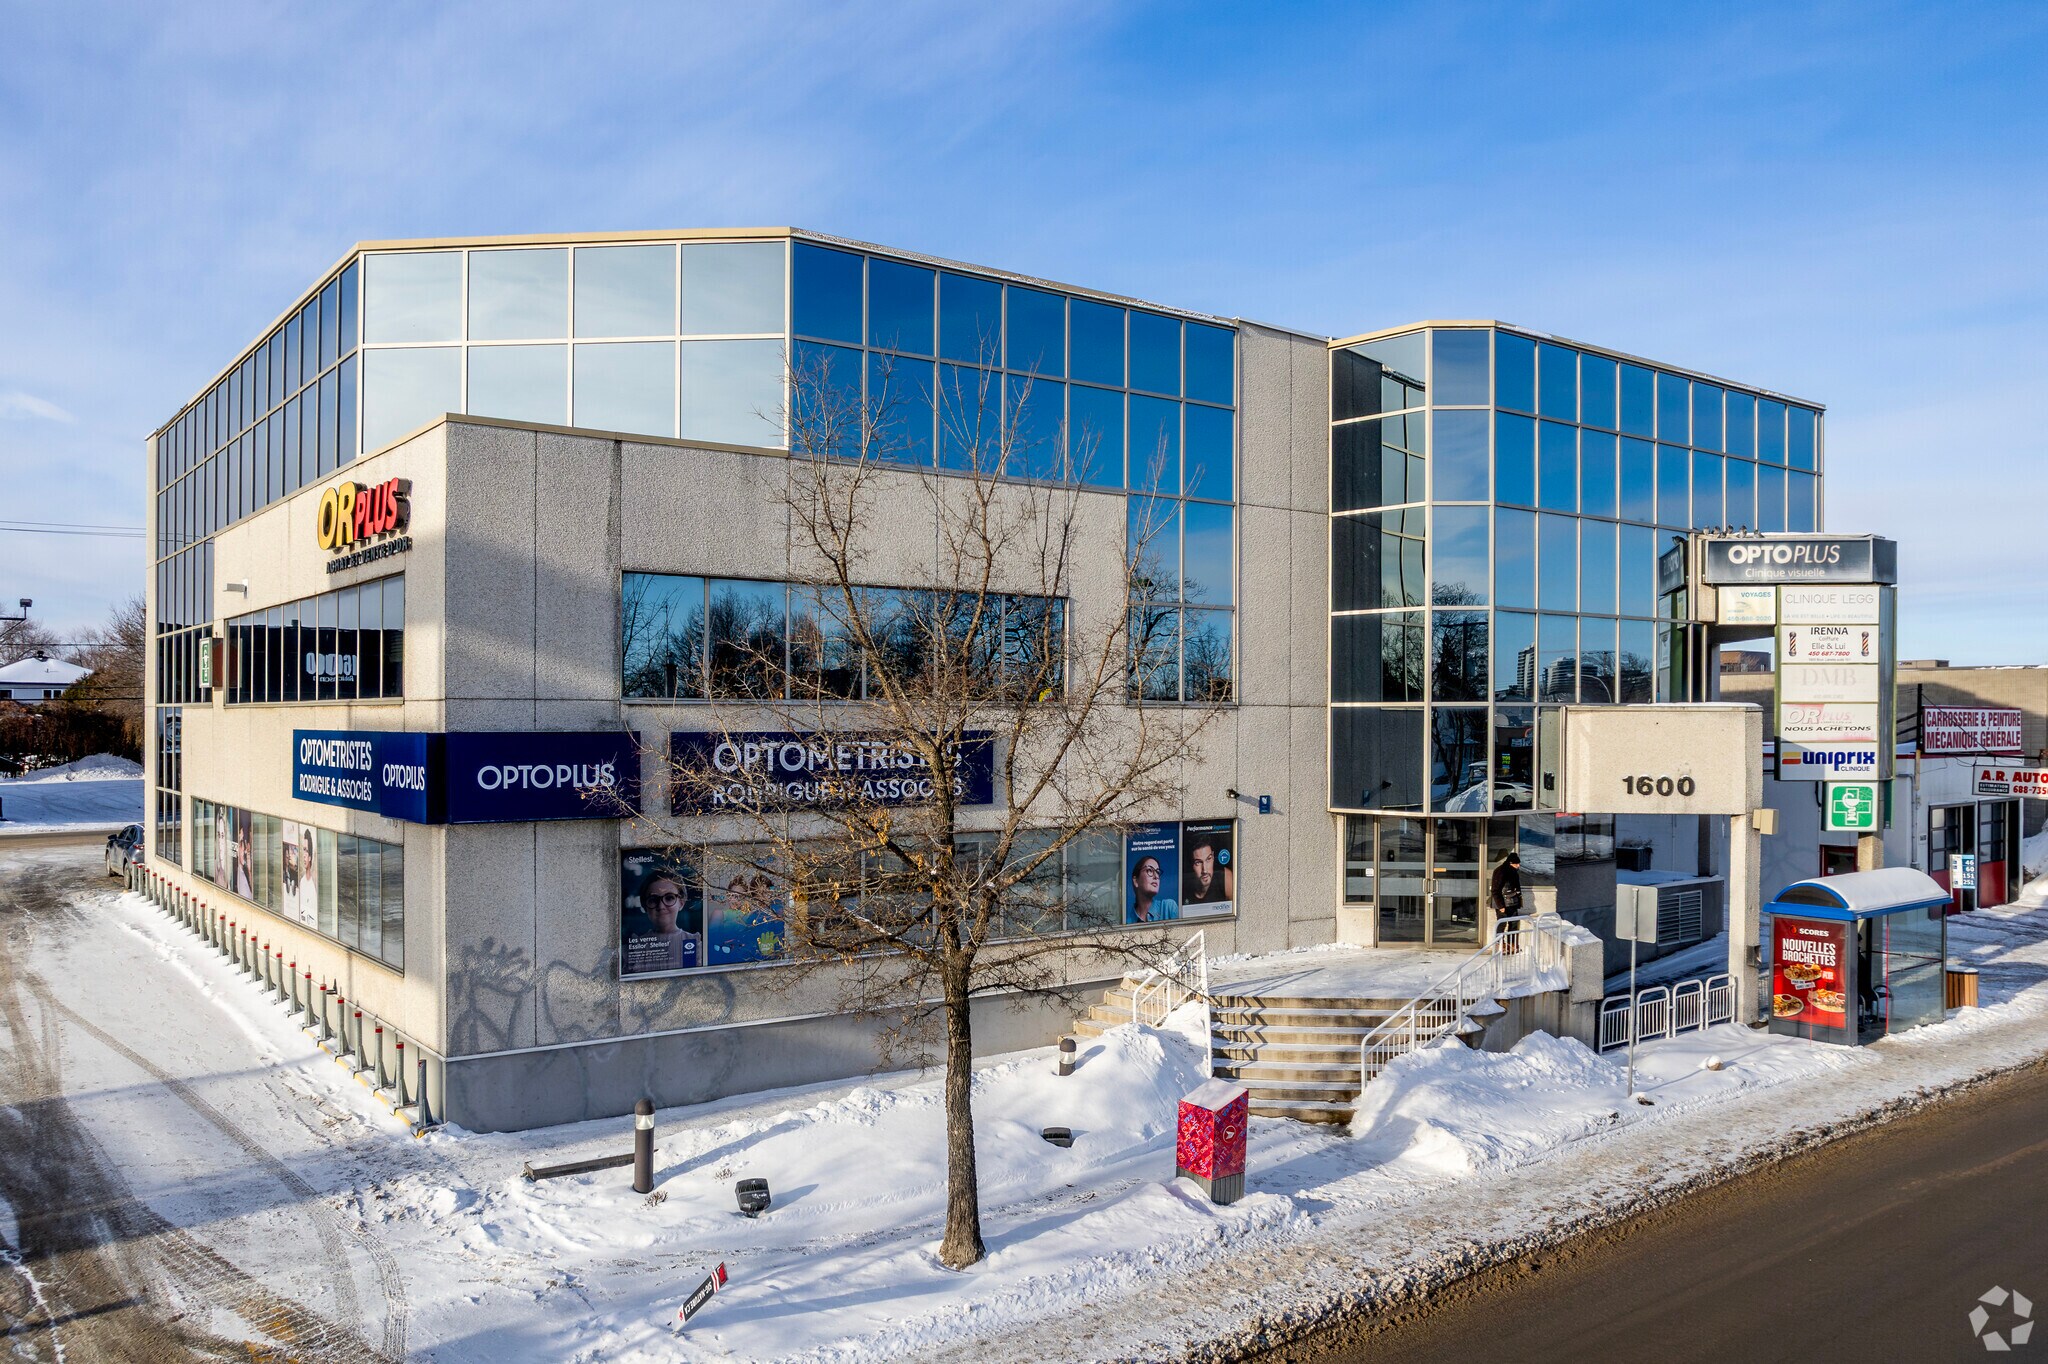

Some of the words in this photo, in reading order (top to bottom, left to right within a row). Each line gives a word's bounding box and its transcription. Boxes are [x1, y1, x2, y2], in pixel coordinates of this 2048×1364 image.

[326, 558, 349, 574] ACHAT
[360, 547, 387, 564] VENTE
[1728, 544, 1840, 564] OPTOPLUS
[1745, 568, 1786, 580] Clinique
[1787, 568, 1826, 577] visuelle
[1785, 594, 1836, 604] CLINIQUE
[1843, 594, 1874, 604] LEGG
[1810, 627, 1849, 635] IRENNA
[1801, 668, 1857, 686] DMB
[1926, 711, 1979, 728] CARROSSERIE
[1980, 712, 1986, 726] &
[1988, 712, 2021, 727] PEINTURE
[1926, 727, 1978, 750] MÉCANIQUE
[1980, 727, 2021, 748] GÉNÉRALE
[300, 738, 372, 771] OPTOMETRISTES
[714, 739, 962, 773] OPTOMETRISS
[1802, 751, 1875, 771] uniprix
[382, 763, 425, 791] OPTOPLUS
[477, 763, 615, 790] OPTOPLUS
[1981, 769, 2008, 782] A.R.
[299, 773, 331, 795] RODRIGUE
[331, 777, 336, 797] &
[337, 777, 372, 801] ASSOCIÉS
[860, 777, 962, 799] ASSOCS
[1622, 775, 1696, 797] 1600
[2013, 785, 2048, 795] 688-735
[1799, 928, 1829, 937] SCORES
[1782, 938, 1836, 955] NOUVELLES
[1782, 950, 1836, 967] BROCHETTES
